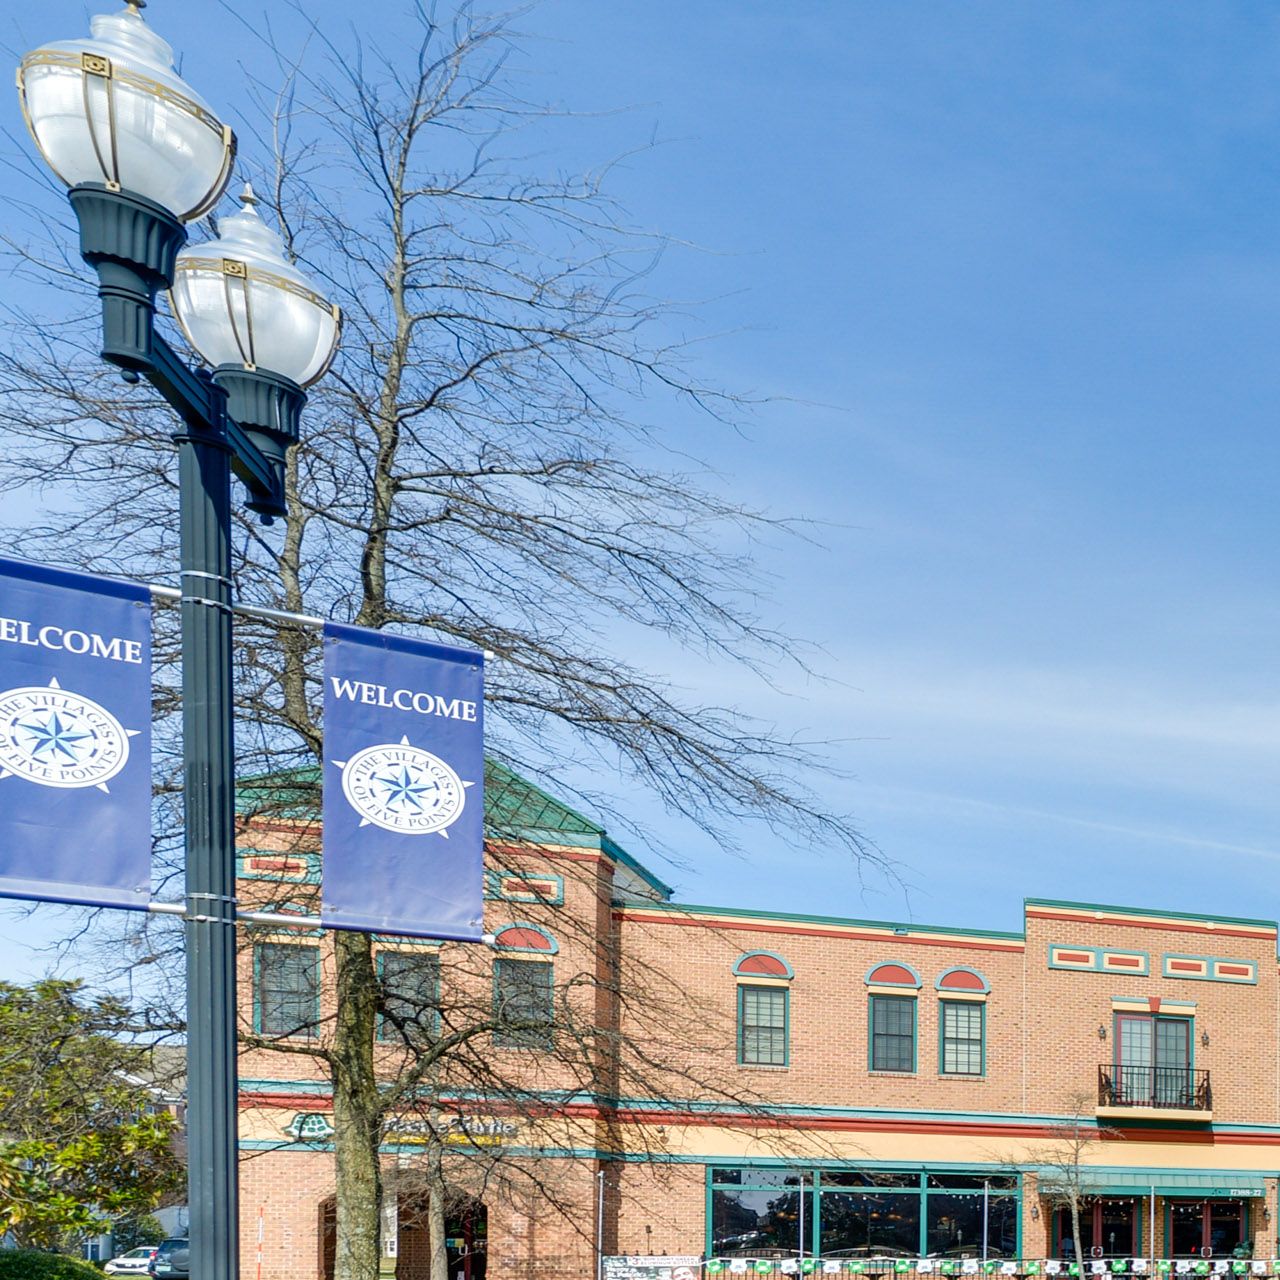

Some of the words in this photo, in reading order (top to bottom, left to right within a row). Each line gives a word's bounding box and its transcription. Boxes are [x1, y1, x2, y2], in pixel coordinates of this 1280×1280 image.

[0, 617, 143, 664] ELCOME
[26, 695, 116, 740] VILLAGES
[330, 676, 478, 722] WELCOME
[8, 753, 53, 778] FIVE
[60, 748, 117, 780] POINTS
[354, 754, 382, 776] THE
[381, 751, 454, 790] VILLAGES
[353, 784, 370, 801] OF
[366, 803, 403, 826] FIVE
[408, 798, 456, 827] POINTS
